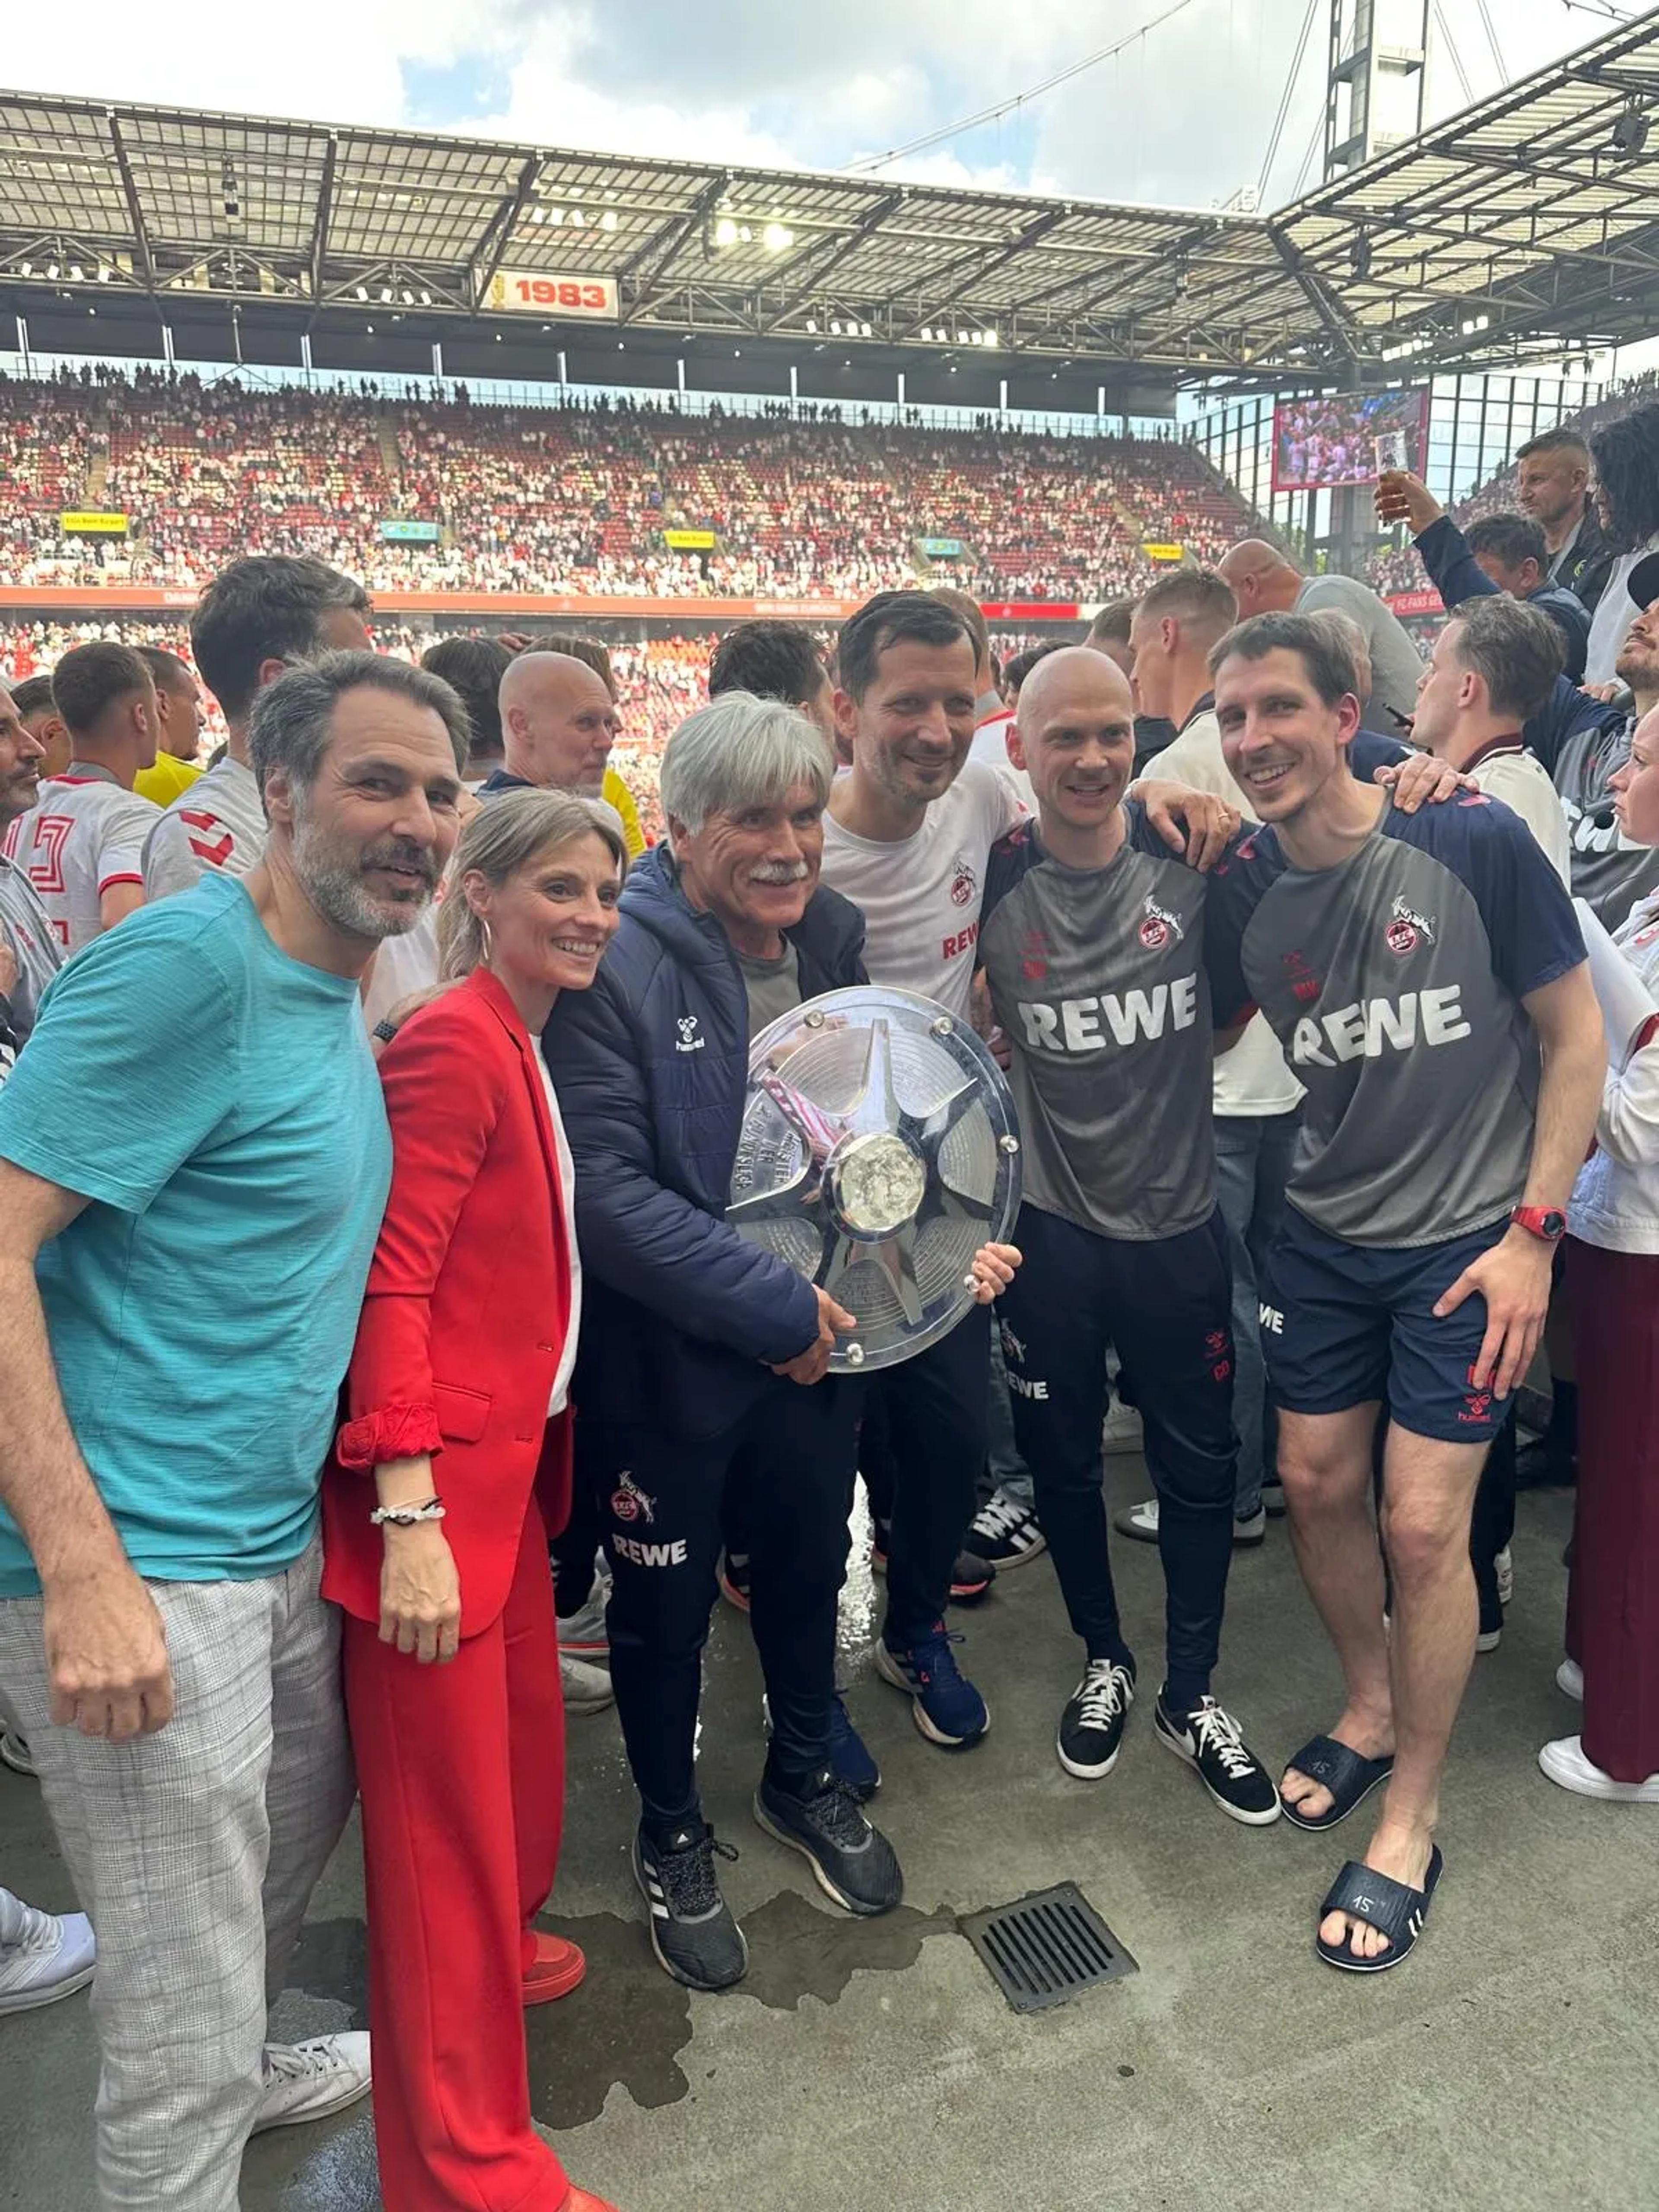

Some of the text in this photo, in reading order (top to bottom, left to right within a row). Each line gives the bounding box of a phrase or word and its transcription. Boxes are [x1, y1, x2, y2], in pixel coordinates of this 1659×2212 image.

[516, 280, 606, 308] 1983
[1018, 973, 1197, 1051] REWE
[612, 1533, 688, 1567] REWE
[1312, 1760, 1331, 1774] 15
[1353, 1895, 1374, 1913] 15
